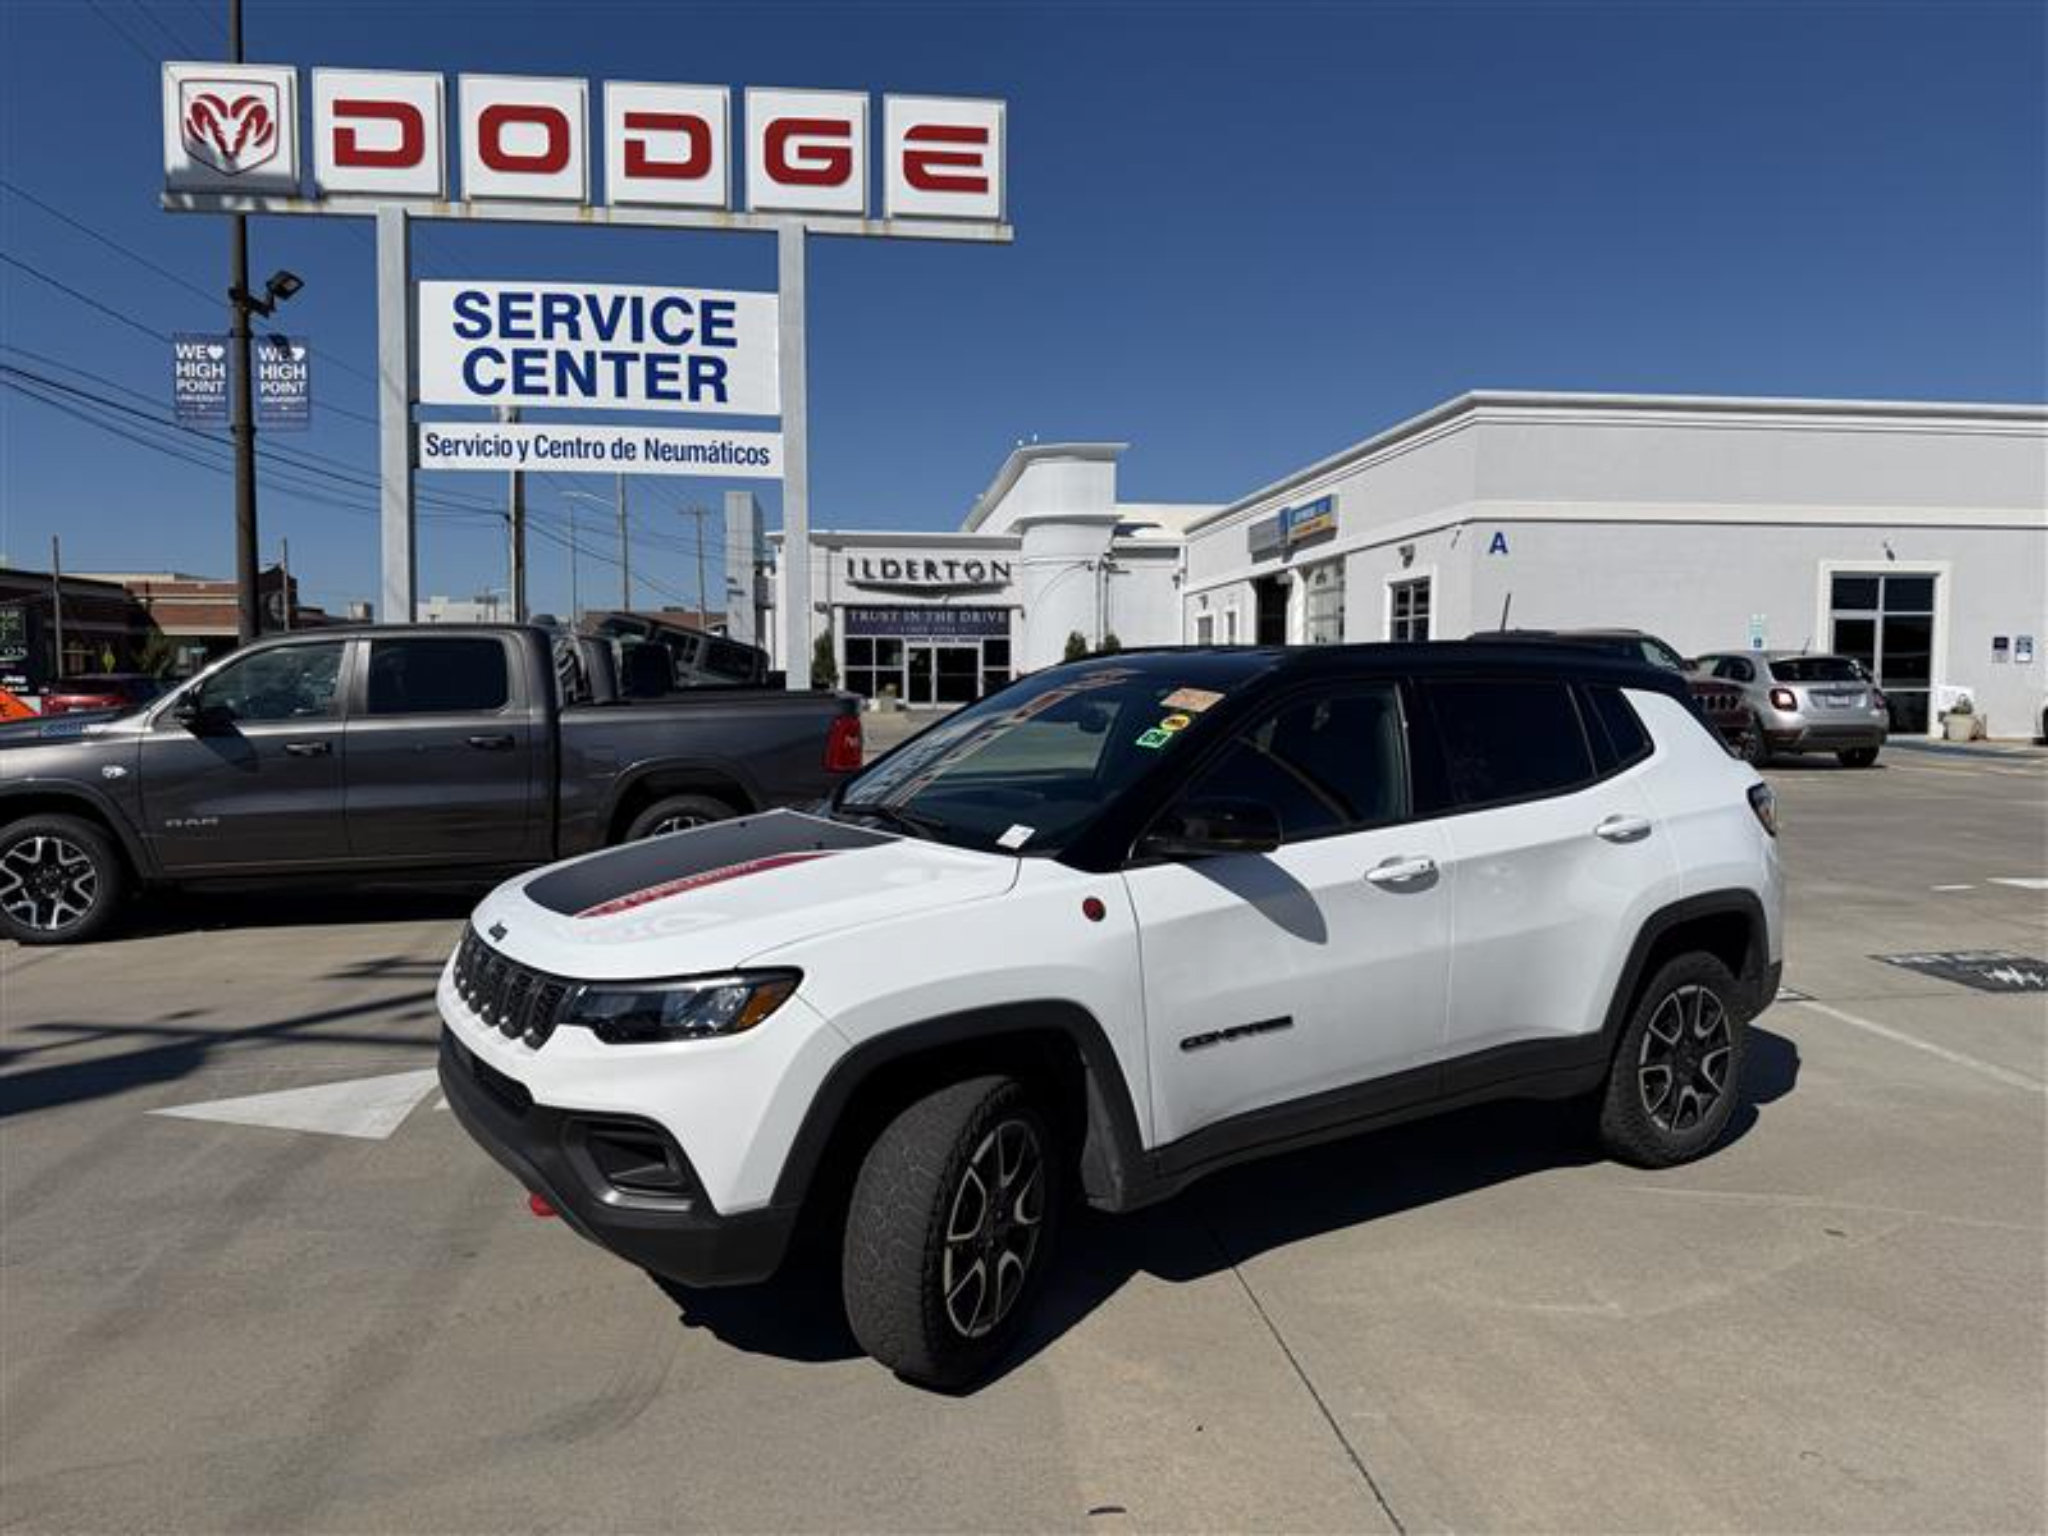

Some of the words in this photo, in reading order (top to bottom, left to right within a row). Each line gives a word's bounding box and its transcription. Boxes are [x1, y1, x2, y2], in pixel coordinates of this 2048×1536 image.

[333, 99, 989, 194] DODGE
[452, 290, 738, 349] SERVICE
[176, 344, 207, 359] WE
[176, 361, 226, 378] HIGH
[260, 363, 306, 379] HIGH
[462, 347, 728, 403] CENTER
[176, 378, 226, 393] POINT
[260, 381, 306, 394] POINT
[425, 432, 513, 458] Servicio
[518, 439, 529, 463] y
[535, 434, 606, 461] Centro
[611, 436, 637, 461] de
[644, 437, 771, 466] Neumáticos
[1489, 531, 1508, 554] A
[847, 558, 1010, 583] ILDERTON
[959, 611, 1007, 623] DRIVE
